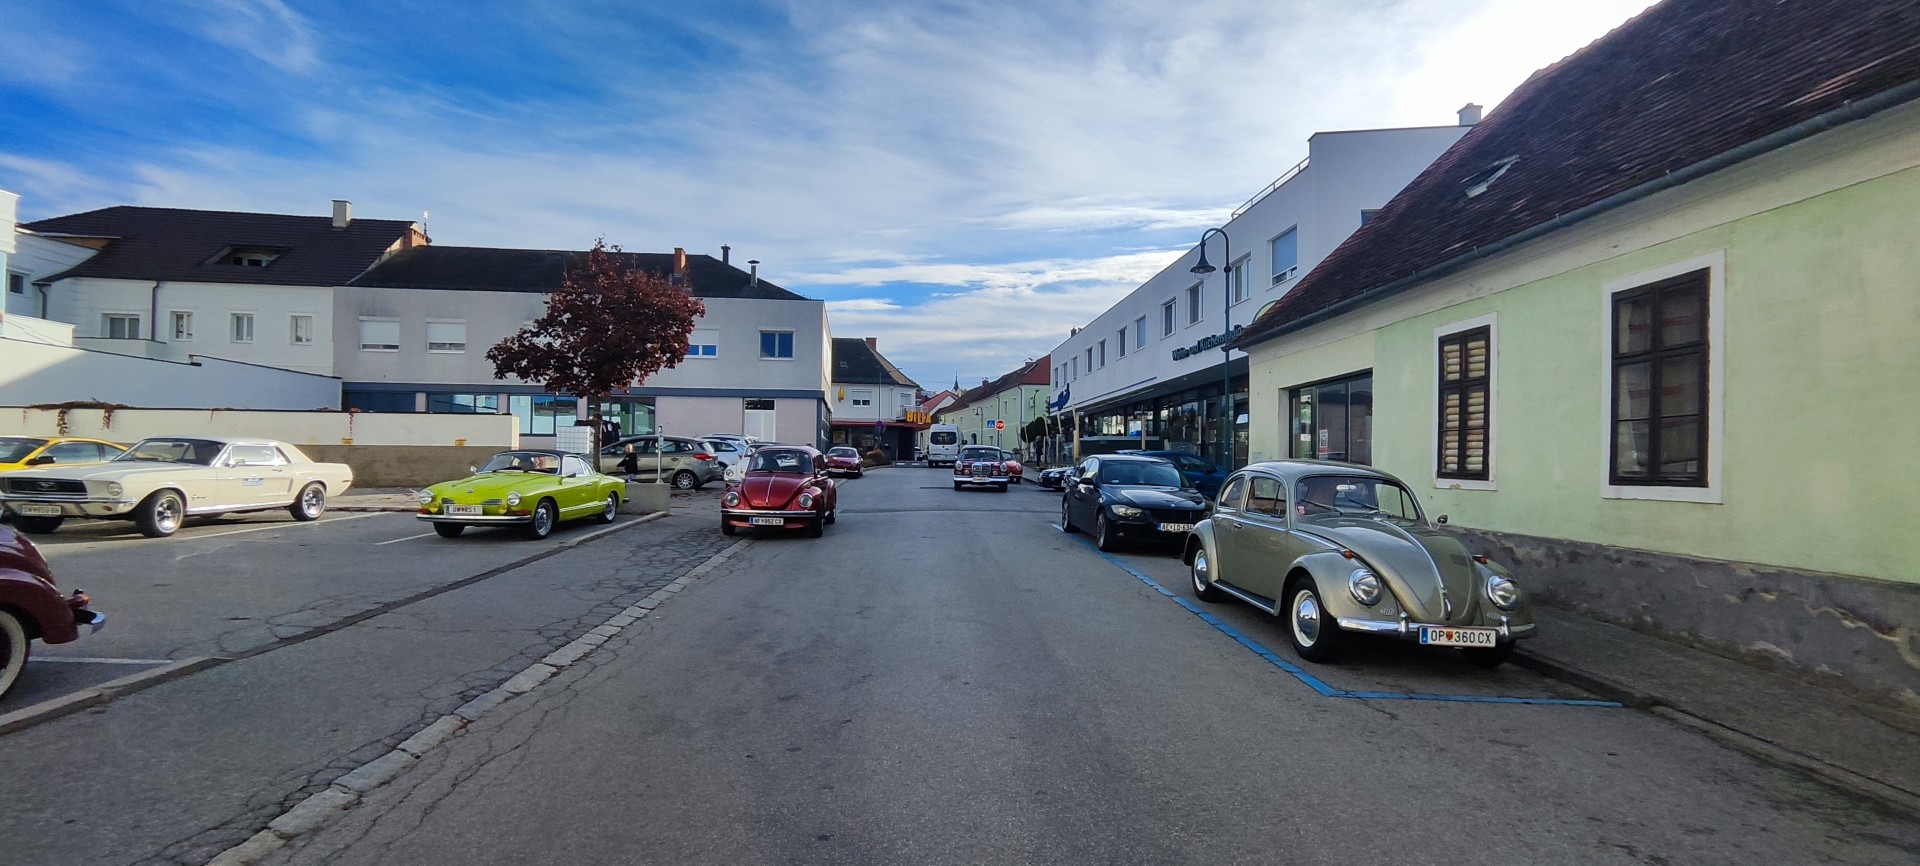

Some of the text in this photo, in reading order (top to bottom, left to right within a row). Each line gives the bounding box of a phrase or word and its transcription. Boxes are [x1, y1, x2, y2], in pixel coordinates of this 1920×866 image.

[906, 411, 932, 423] BILLA
[1430, 629, 1492, 644] OP 360 CX
